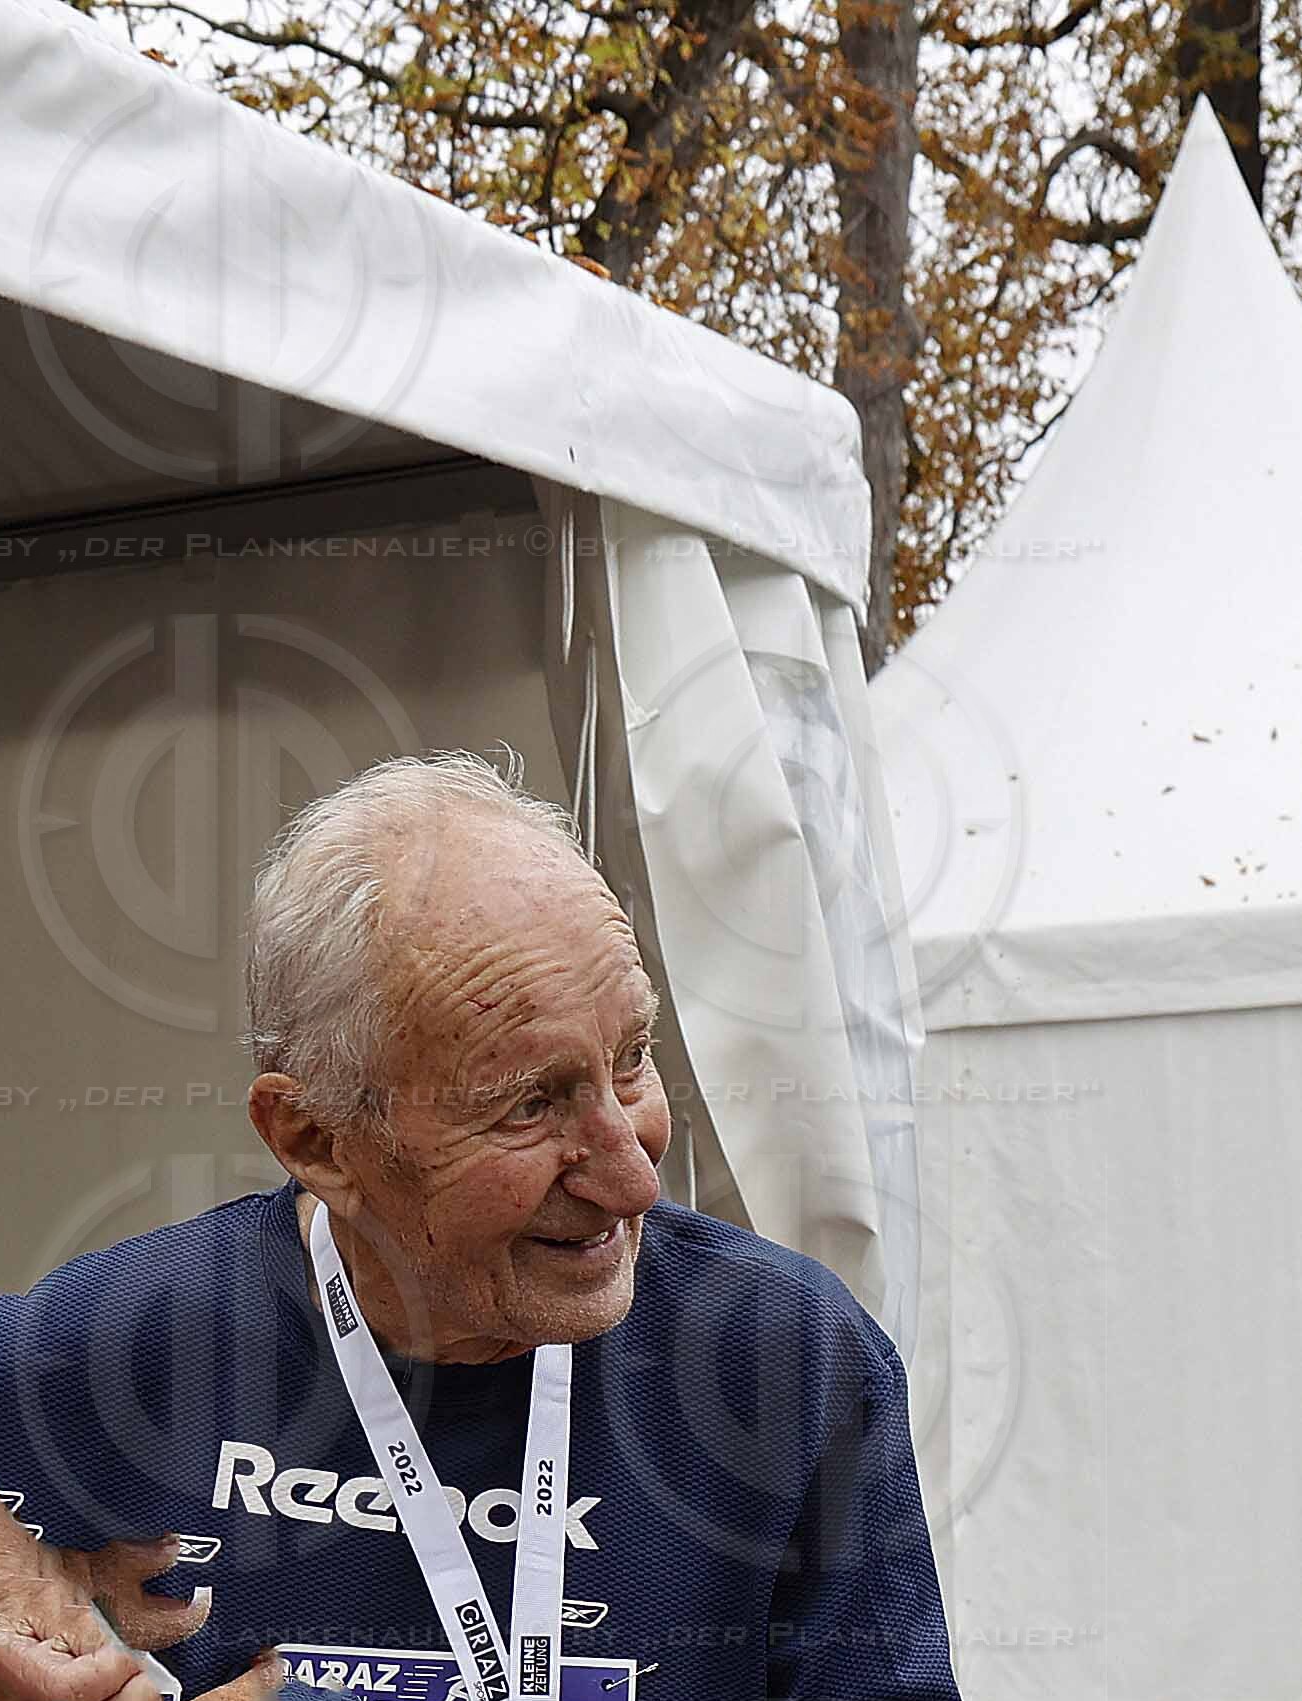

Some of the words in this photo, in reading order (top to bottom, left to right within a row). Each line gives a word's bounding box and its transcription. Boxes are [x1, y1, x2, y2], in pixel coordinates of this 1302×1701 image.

[328, 1285, 348, 1334] ZEITUNG
[333, 1277, 356, 1329] KLEINE
[387, 1440, 424, 1497] 2022
[536, 1458, 554, 1516] 2022
[459, 1605, 507, 1700] GRAZ
[523, 1638, 535, 1693] KLEINE
[535, 1638, 548, 1693] ZEITUNG
